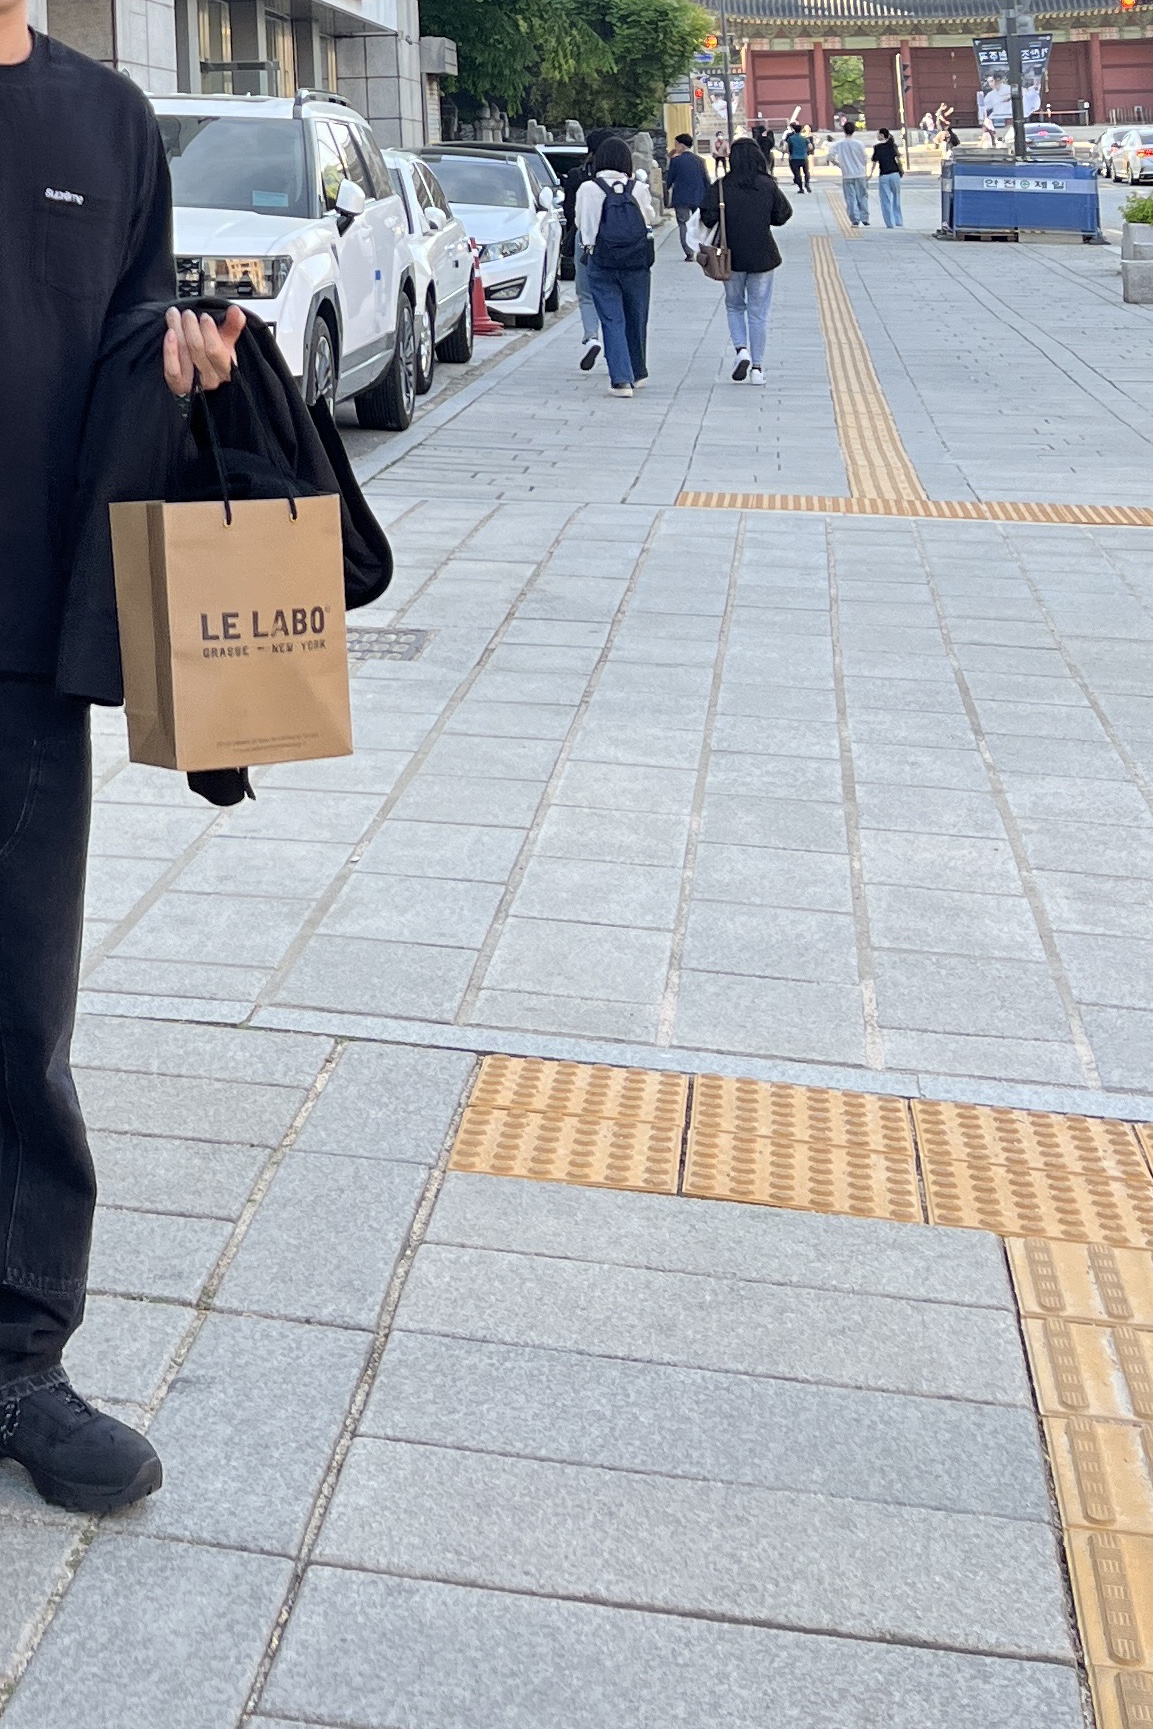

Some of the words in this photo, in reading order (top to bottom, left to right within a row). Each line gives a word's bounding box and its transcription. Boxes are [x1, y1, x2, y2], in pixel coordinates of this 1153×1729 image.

[985, 179, 1016, 189] 안전
[201, 611, 241, 641] LE
[252, 606, 325, 638] LABO
[202, 645, 249, 659] GRASSE
[271, 643, 294, 654] NEW
[301, 639, 327, 652] YORK
